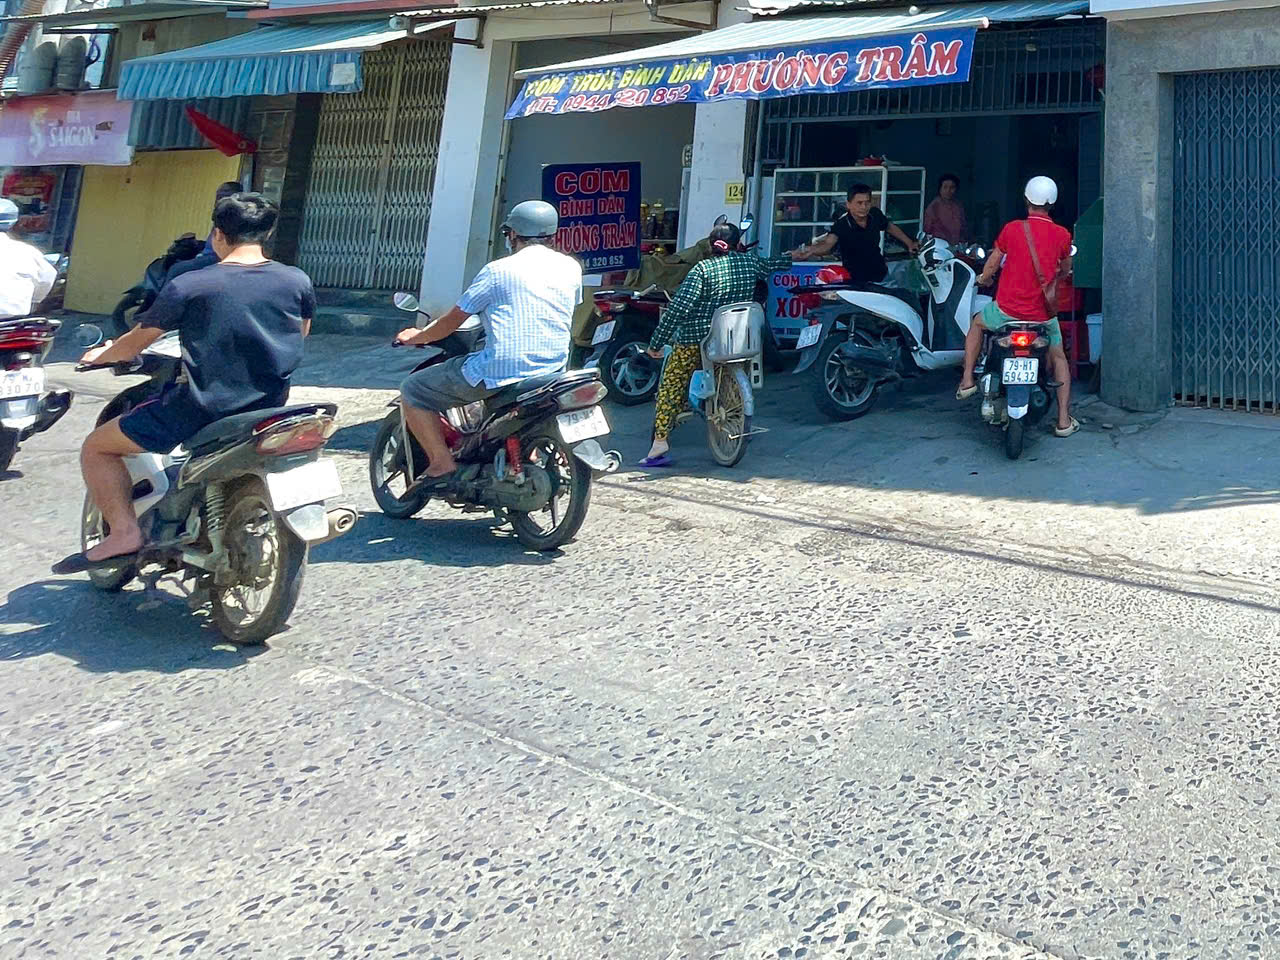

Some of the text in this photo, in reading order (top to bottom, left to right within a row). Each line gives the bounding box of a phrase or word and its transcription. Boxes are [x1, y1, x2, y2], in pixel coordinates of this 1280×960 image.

[618, 64, 665, 89] BÌNH
[668, 58, 712, 84] DÂN
[705, 33, 963, 97] PHƯƠNG TRÂM
[651, 83, 691, 103] 852
[555, 168, 630, 195] CƠM
[560, 194, 625, 218] BÌNH DÂN
[602, 215, 637, 250] TRÂM
[592, 256, 607, 267] 320
[609, 254, 624, 266] 852
